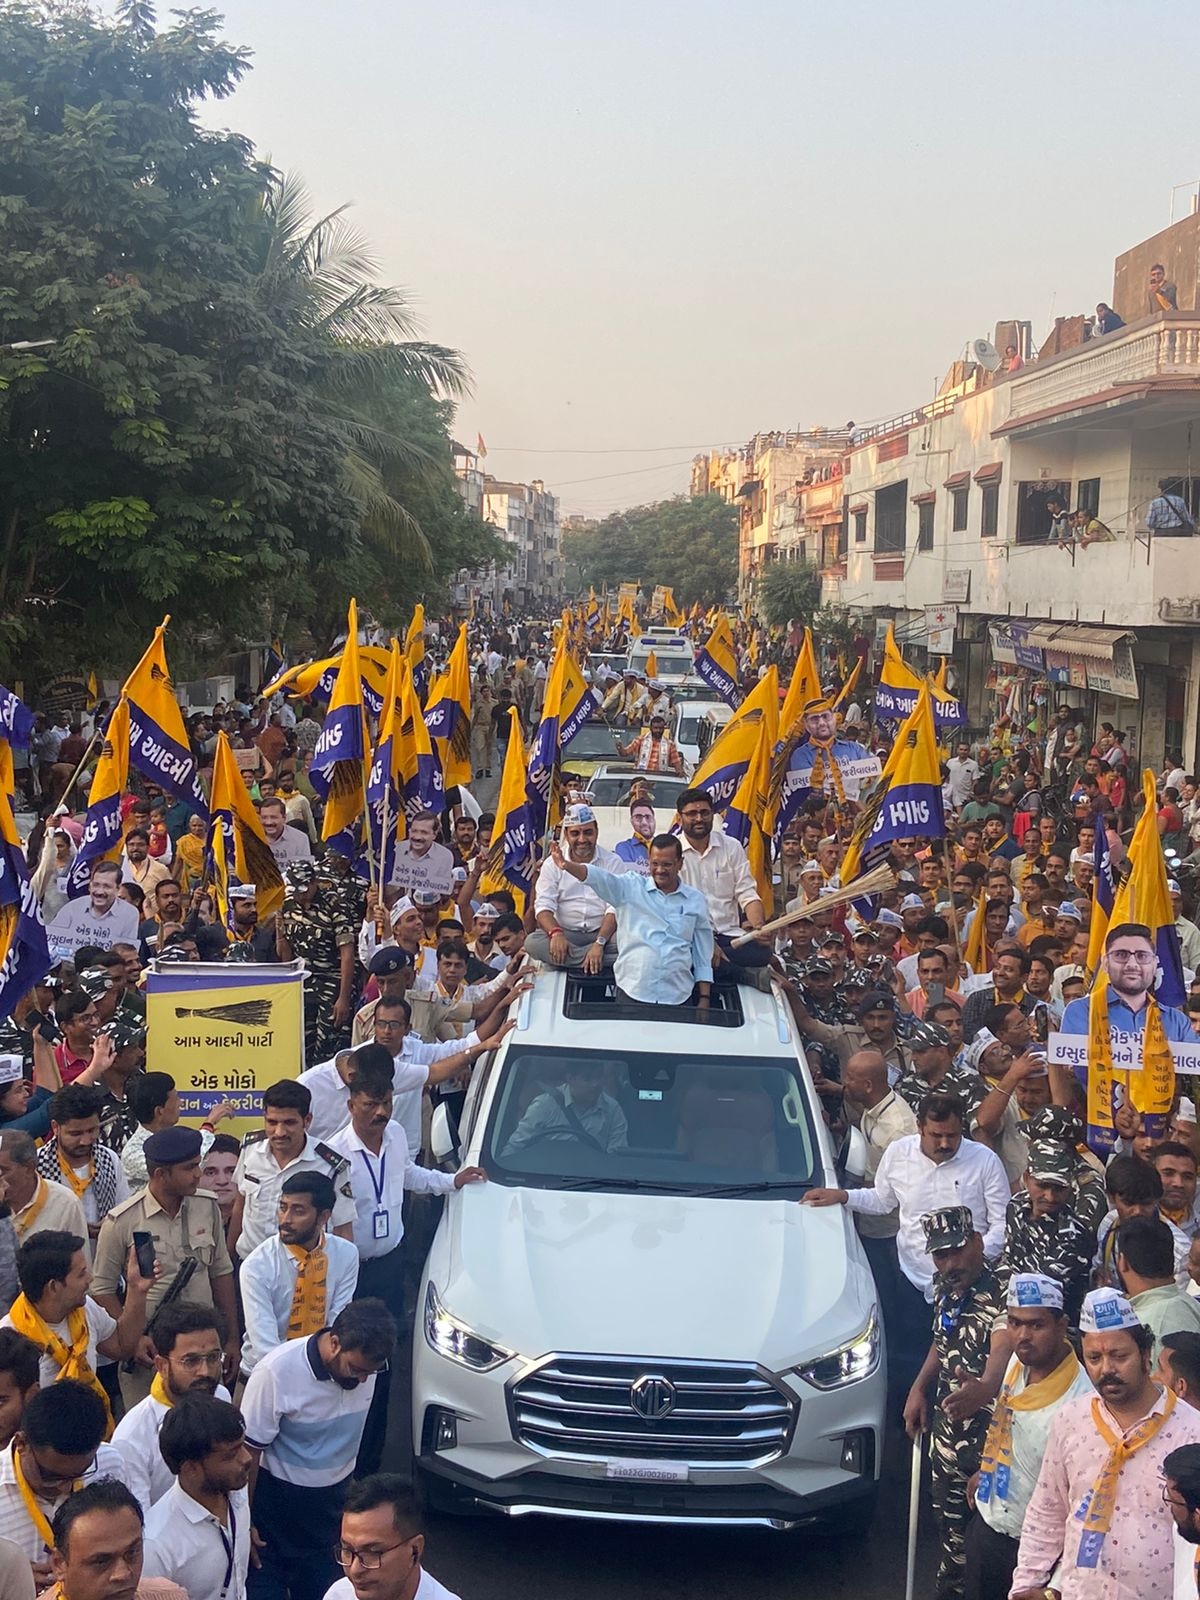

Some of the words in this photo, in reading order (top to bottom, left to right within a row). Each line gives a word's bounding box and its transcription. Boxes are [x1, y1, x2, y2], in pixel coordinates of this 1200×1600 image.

[141, 736, 193, 785] આદમી
[174, 1036, 201, 1048] આમ
[205, 1032, 244, 1048] આદમી
[248, 1031, 274, 1047] પાર્ટી
[190, 1069, 219, 1089] એક
[224, 1069, 257, 1089] મોકો
[636, 1380, 671, 1416] MG
